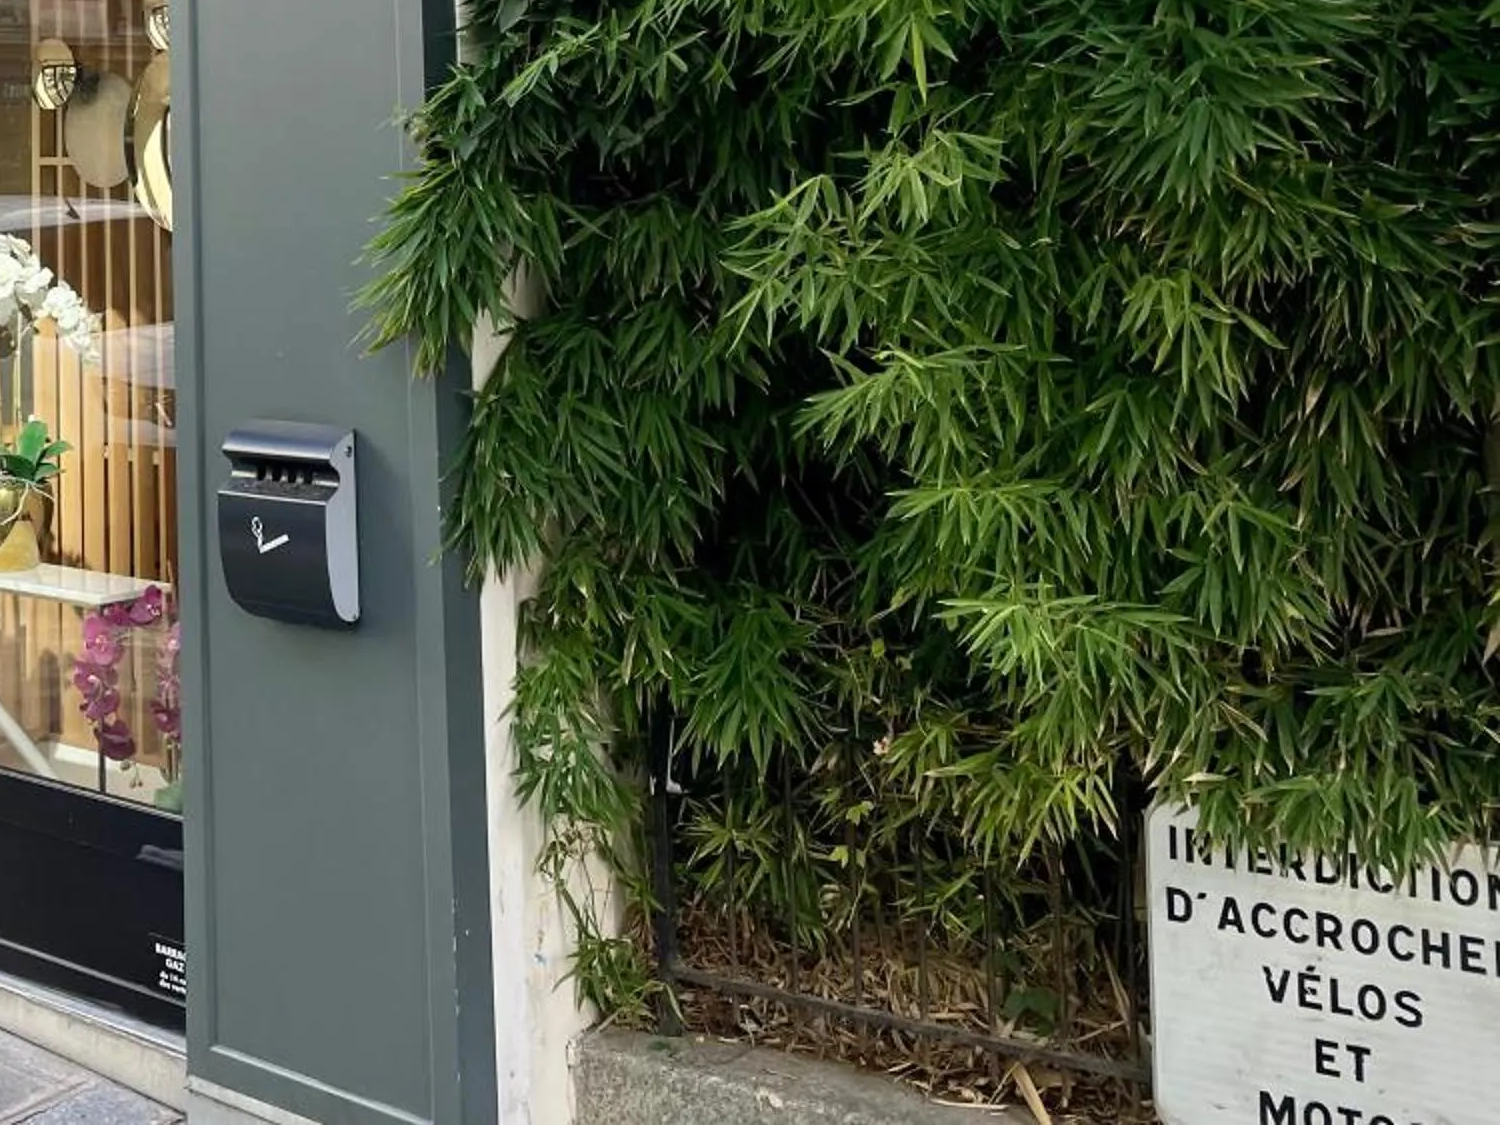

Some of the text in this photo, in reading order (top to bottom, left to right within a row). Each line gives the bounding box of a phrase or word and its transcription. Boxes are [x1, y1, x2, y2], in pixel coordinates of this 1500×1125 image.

[1165, 886, 1500, 977] D'ACCROCHE
[1262, 964, 1424, 1028] VÉLOS
[1314, 1038, 1371, 1083] ET
[1259, 1090, 1423, 1125] MOT
